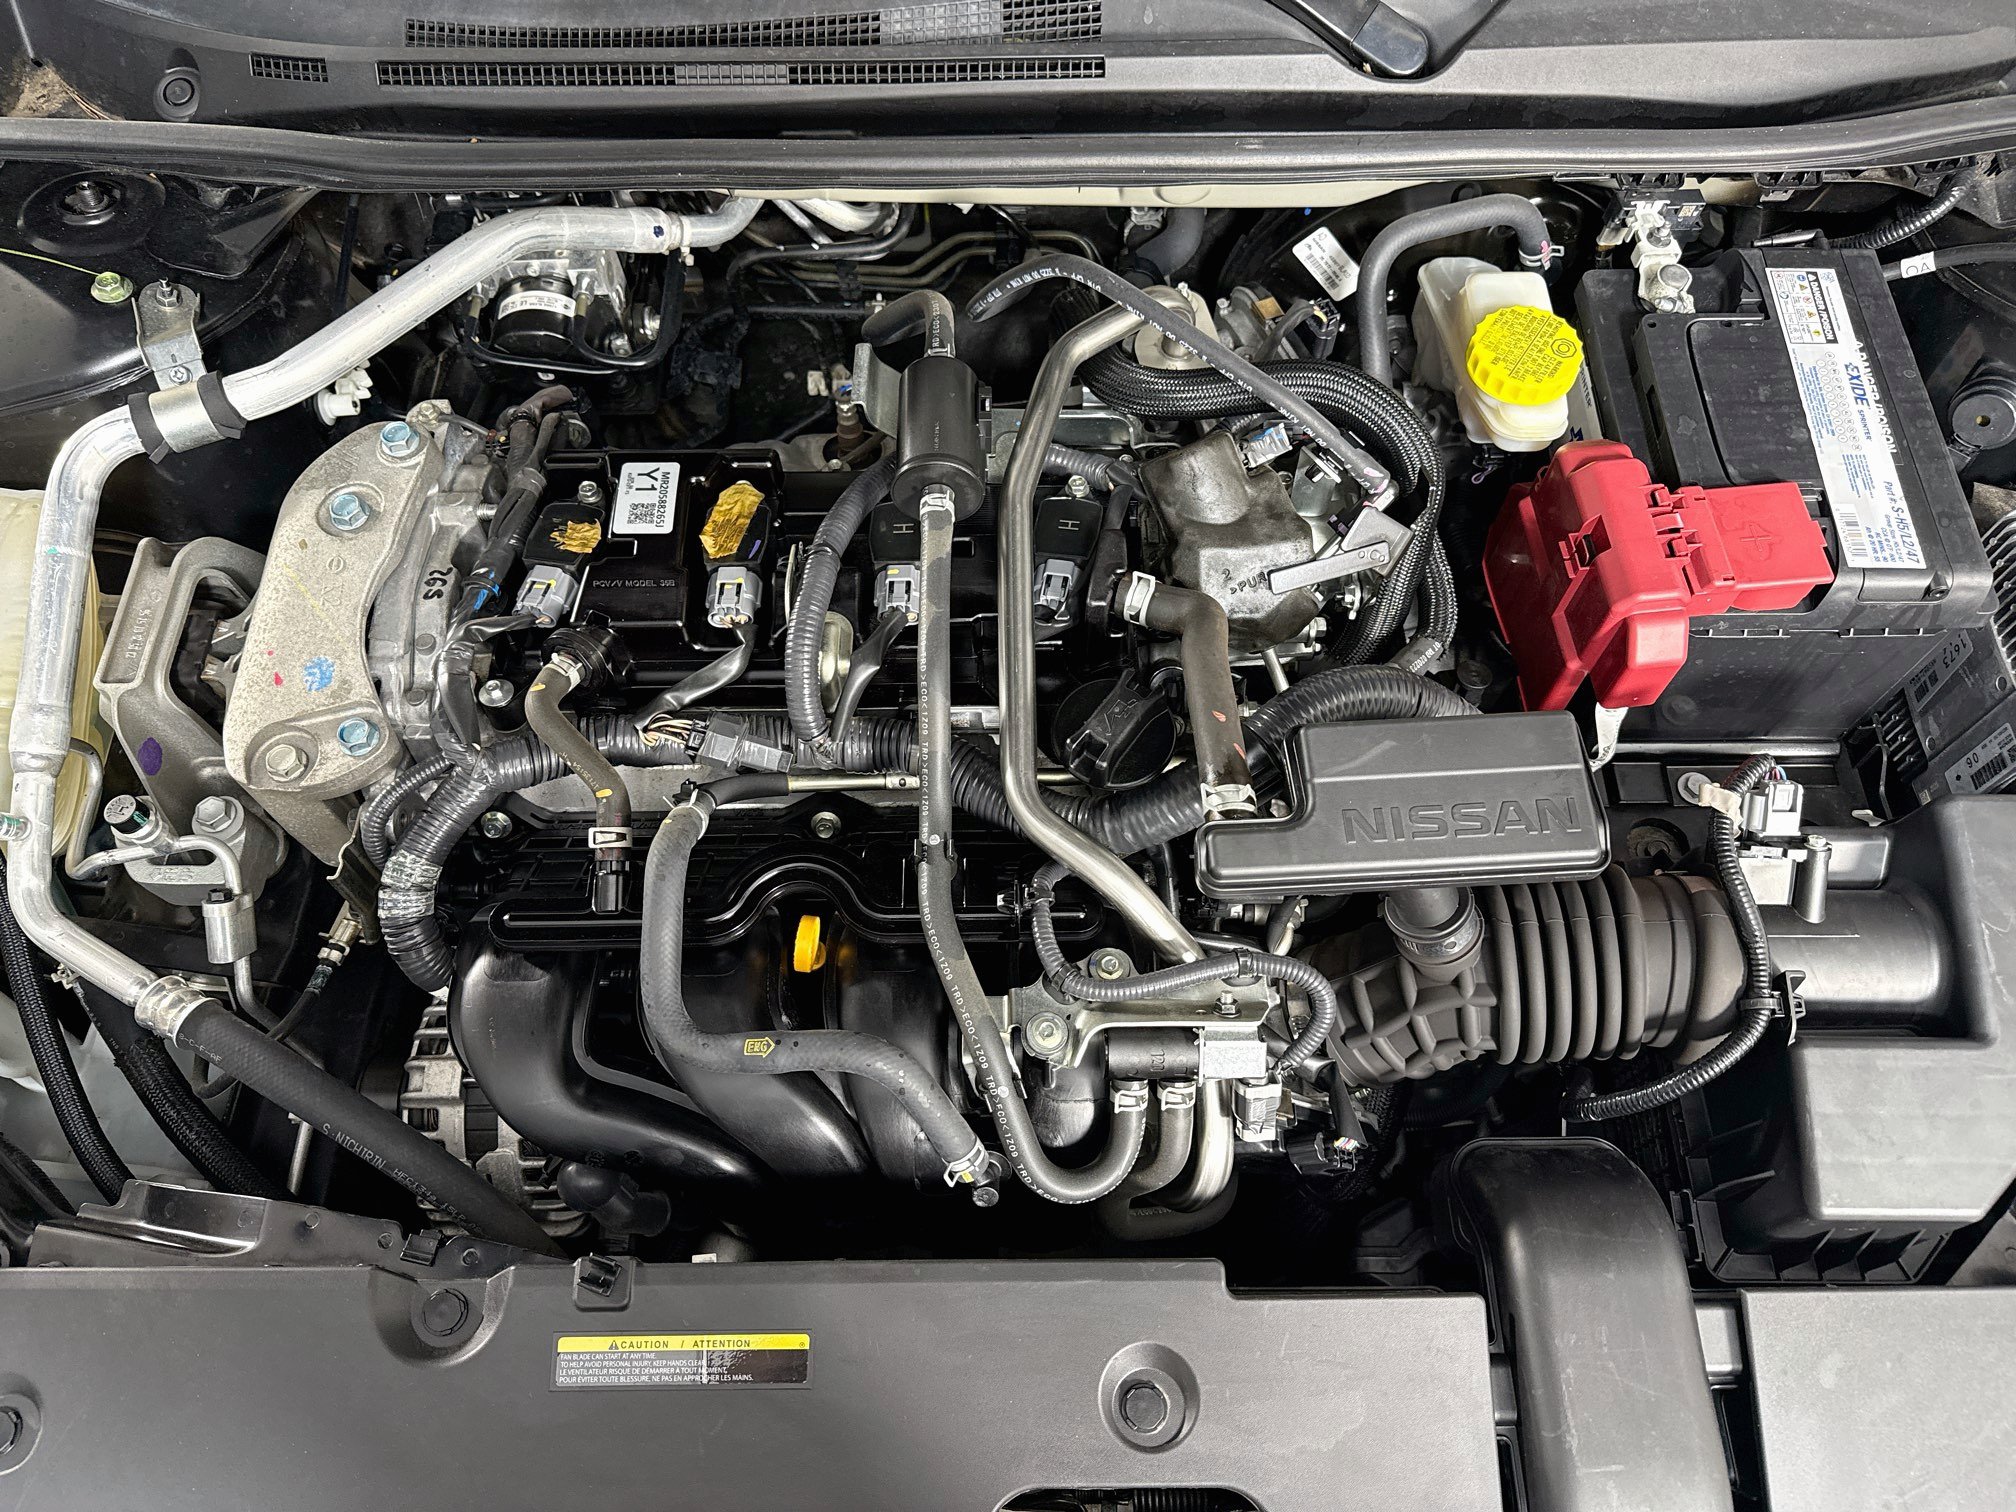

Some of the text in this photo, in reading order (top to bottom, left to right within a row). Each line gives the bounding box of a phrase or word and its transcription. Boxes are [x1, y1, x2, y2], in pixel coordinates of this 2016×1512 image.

[1844, 362, 1870, 408] EXIDE
[635, 467, 660, 491] Y1
[1342, 798, 1582, 844] NISSAN
[620, 1340, 670, 1349] CAUTION
[692, 1339, 751, 1348] ATTENTION
[578, 1375, 598, 1383] ÉVITER
